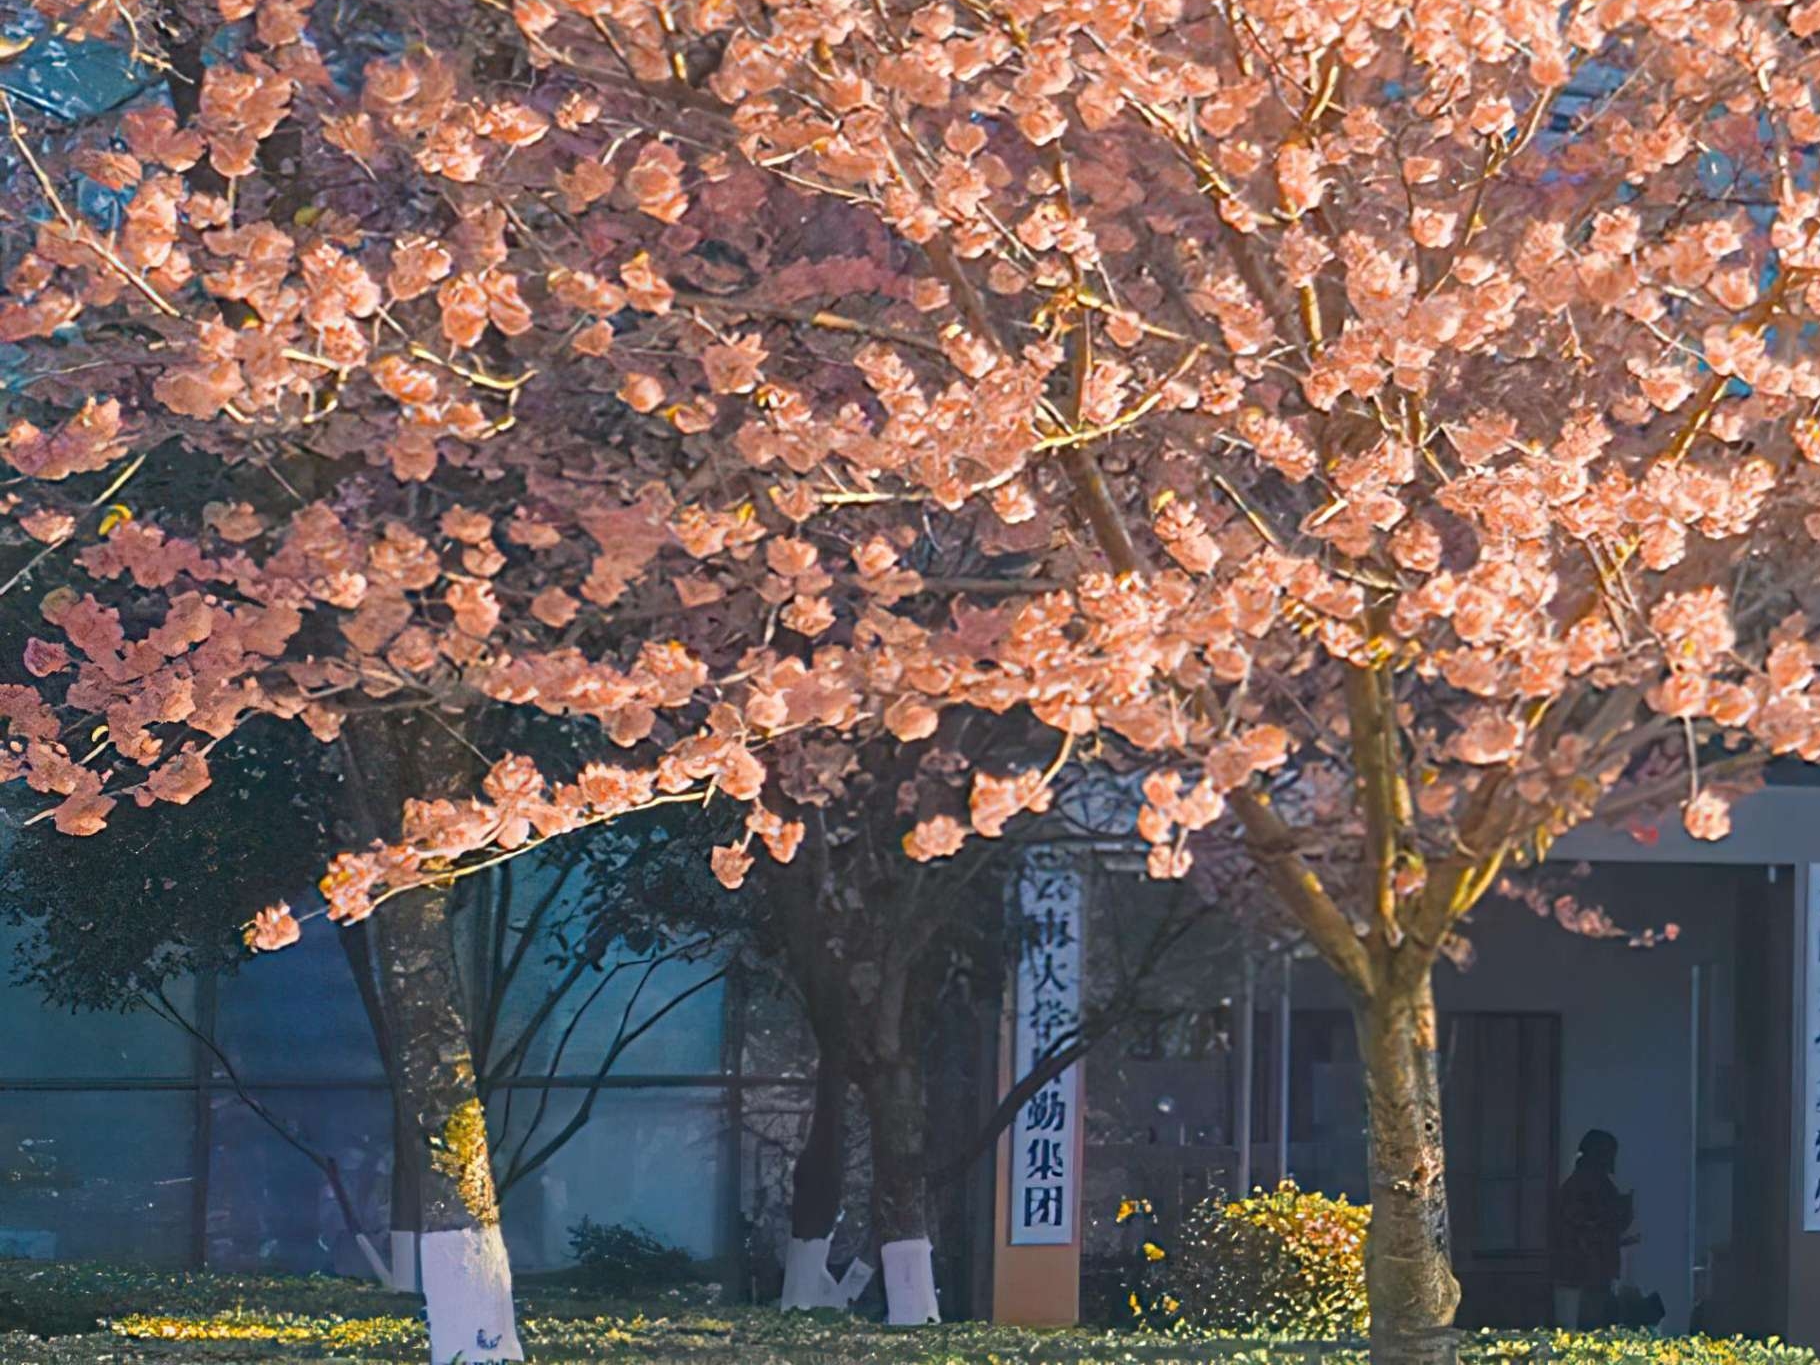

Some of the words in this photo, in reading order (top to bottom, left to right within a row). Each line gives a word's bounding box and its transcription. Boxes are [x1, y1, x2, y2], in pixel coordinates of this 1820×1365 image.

[1022, 863, 1076, 1227] 云南大学勤集团
